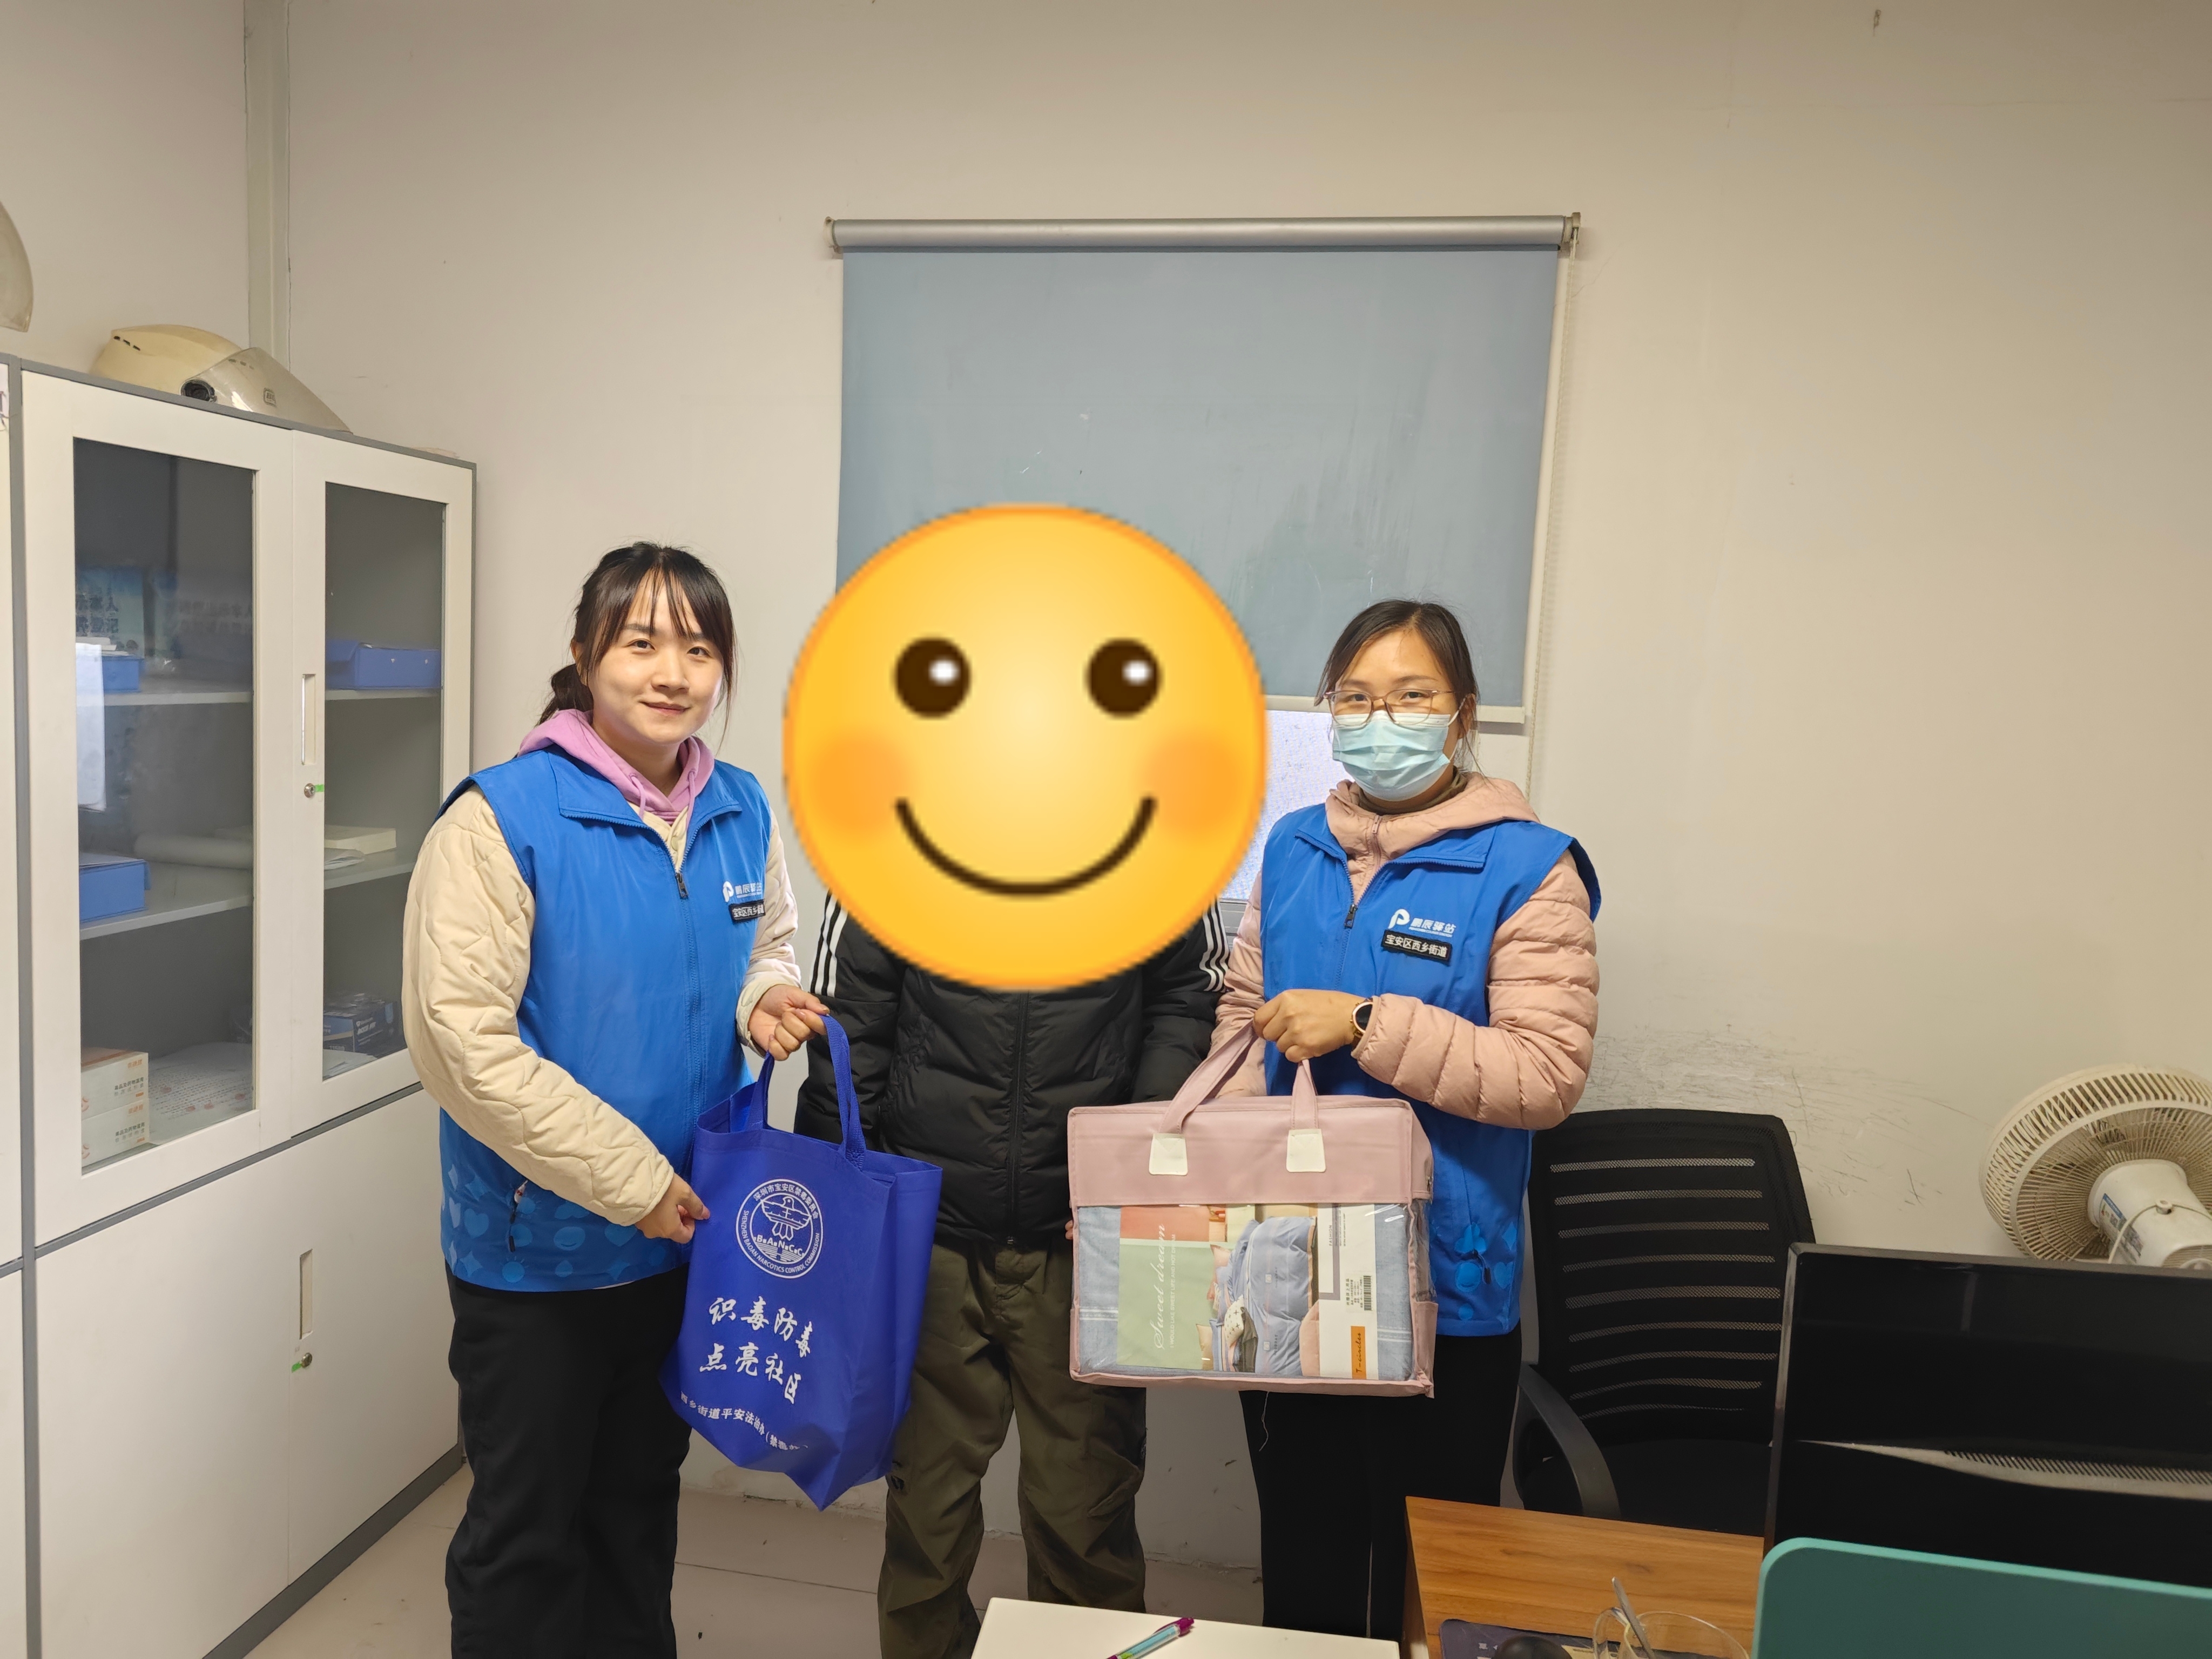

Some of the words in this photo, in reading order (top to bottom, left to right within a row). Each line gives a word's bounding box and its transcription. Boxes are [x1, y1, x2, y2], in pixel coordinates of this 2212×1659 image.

[1385, 934, 1447, 957] 宝安区西乡街道
[753, 1183, 819, 1219] 深圳市宝安区禁毒委员会
[741, 1210, 749, 1239] SHENZHEN
[744, 1239, 758, 1257] BAOAN
[757, 1256, 785, 1272] NARCOTICS
[805, 1232, 820, 1266] COMMISSION
[1150, 1224, 1165, 1283] dream
[785, 1265, 805, 1273] CONTROL
[709, 1296, 812, 1357] 识毒防毒
[1150, 1284, 1165, 1350] Sweet
[699, 1341, 802, 1404] 点亮社区
